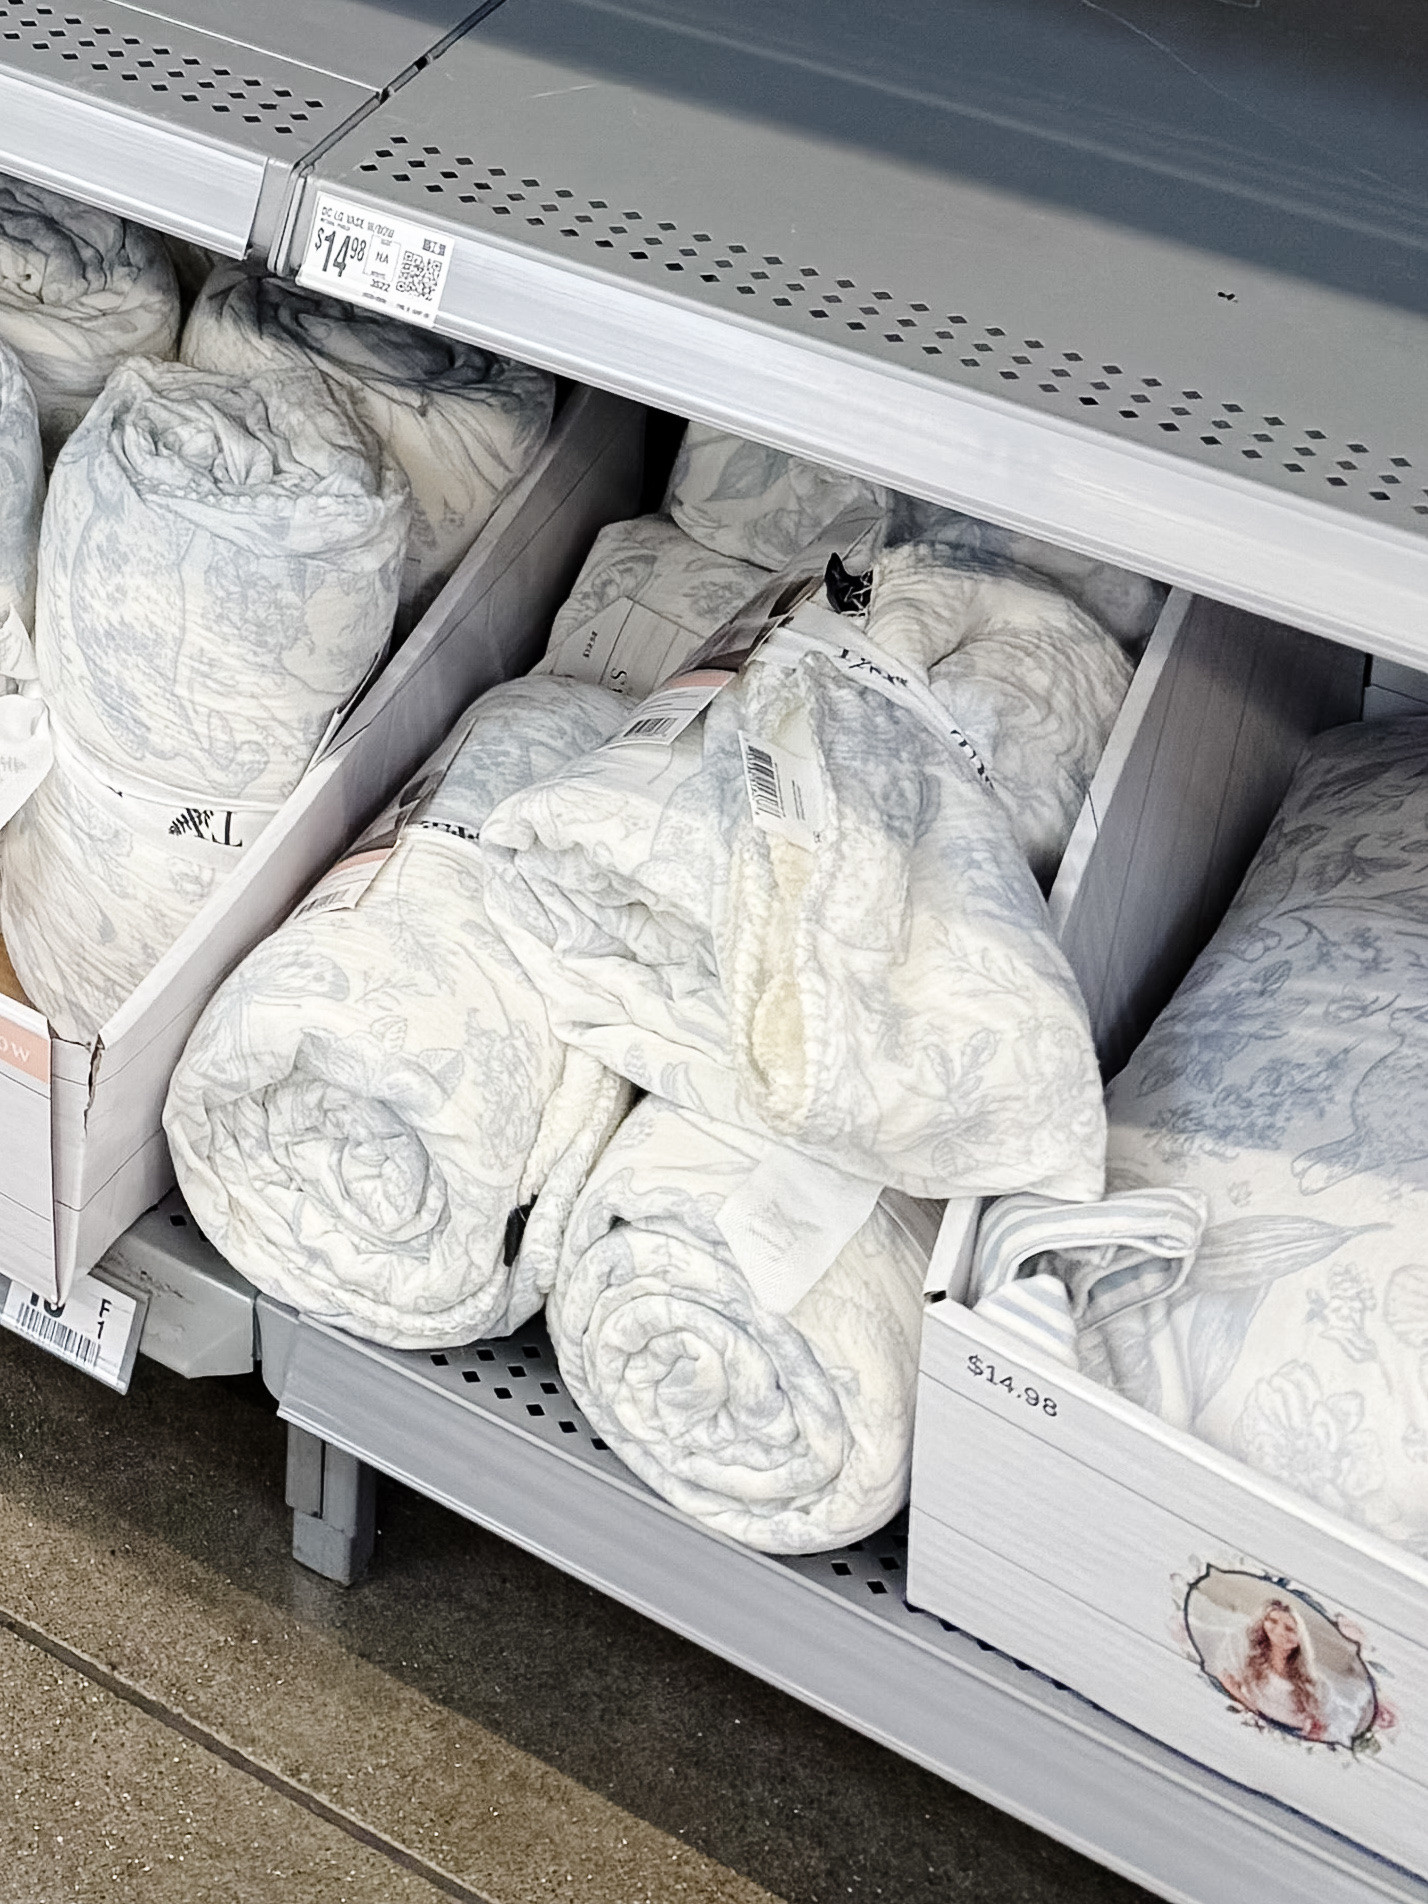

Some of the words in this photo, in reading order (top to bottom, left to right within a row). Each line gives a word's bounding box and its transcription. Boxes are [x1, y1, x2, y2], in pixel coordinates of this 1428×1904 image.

[99, 1298, 112, 1318] F
[96, 1321, 105, 1340] 1
[967, 1352, 1059, 1419] $14.98
